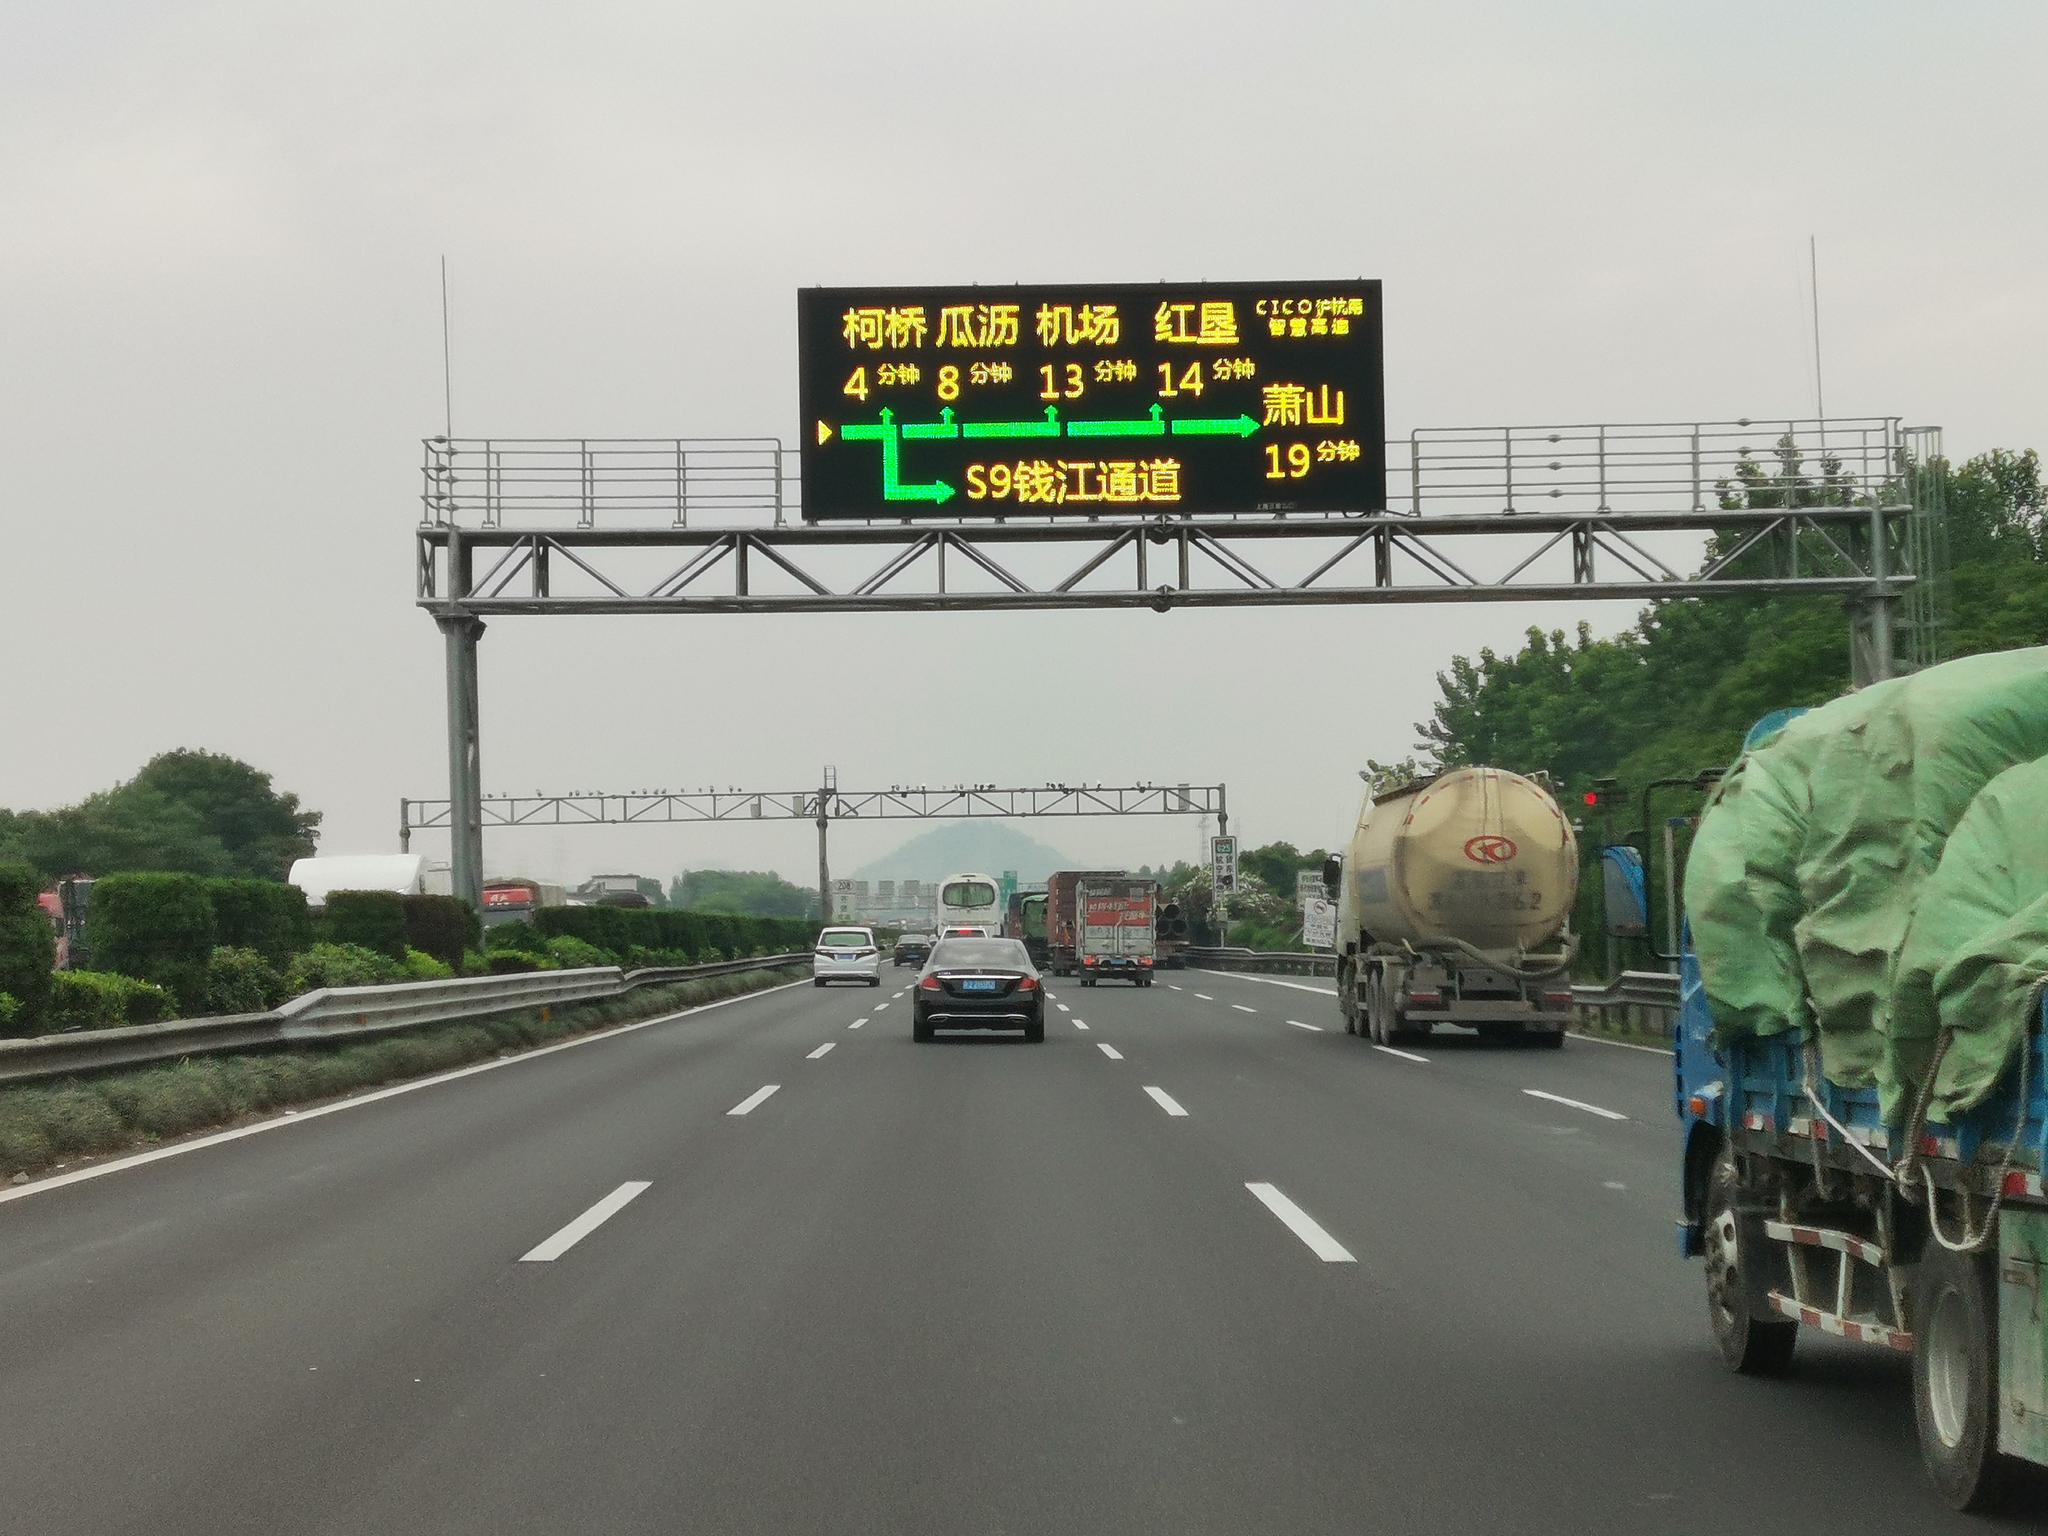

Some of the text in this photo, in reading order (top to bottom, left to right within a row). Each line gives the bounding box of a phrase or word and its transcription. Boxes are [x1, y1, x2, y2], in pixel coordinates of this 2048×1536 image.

[842, 301, 1240, 351] 柯桥 瓜沥 机场 红垦
[1261, 382, 1345, 427] 萧山
[965, 457, 1182, 505] S9钱江通道
